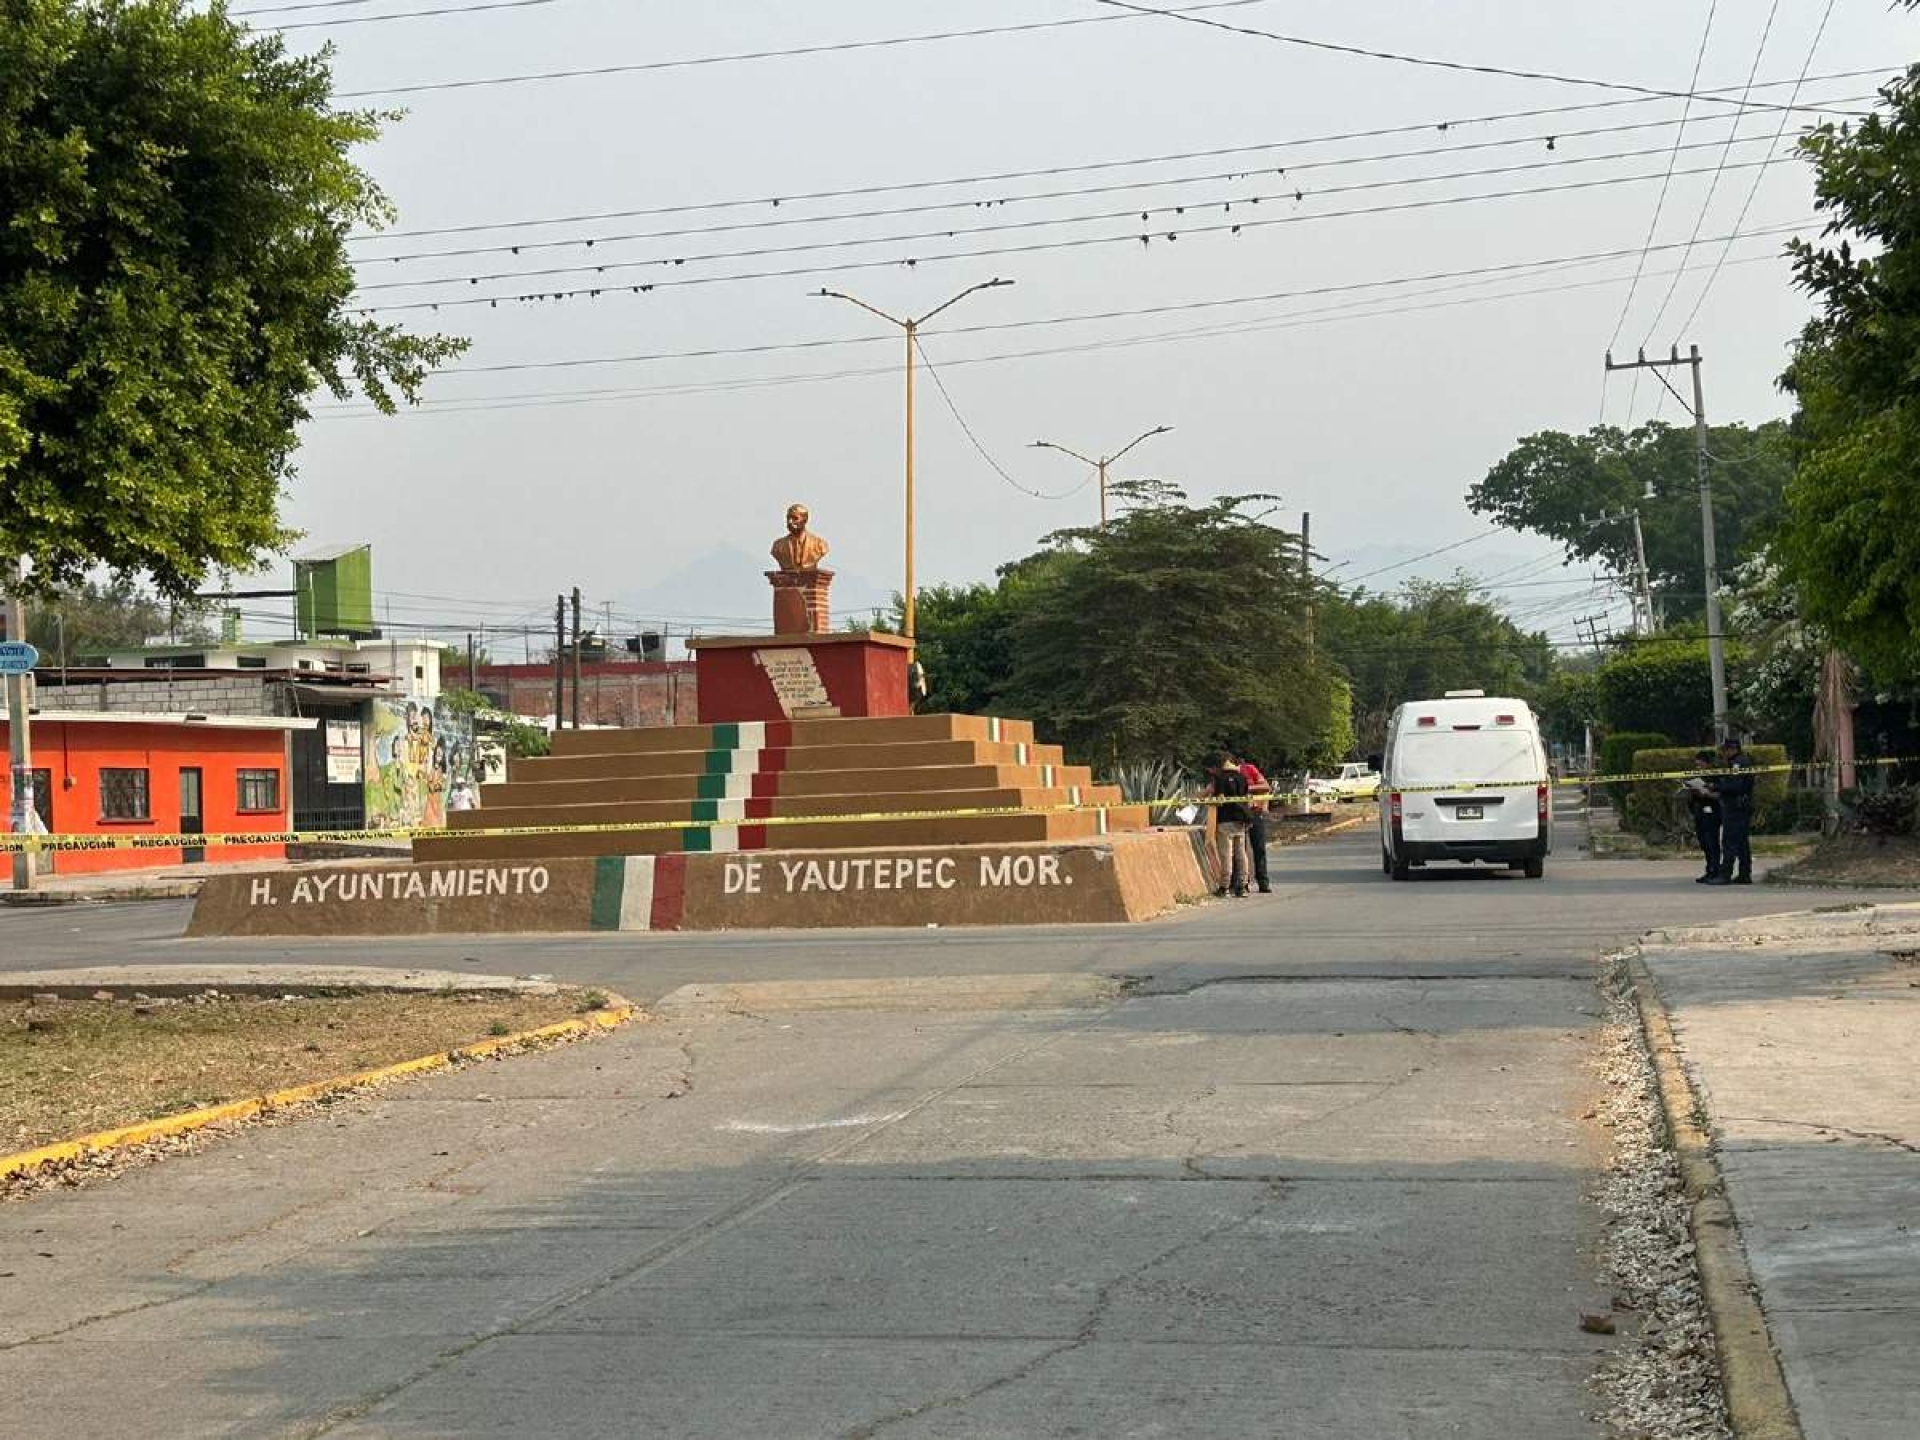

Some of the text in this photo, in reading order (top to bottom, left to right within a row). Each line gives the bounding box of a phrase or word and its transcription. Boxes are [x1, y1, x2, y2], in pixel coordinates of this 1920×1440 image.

[249, 854, 1074, 906] H. AYUNTAMIENTO DE YAUTEPEC MOR.
